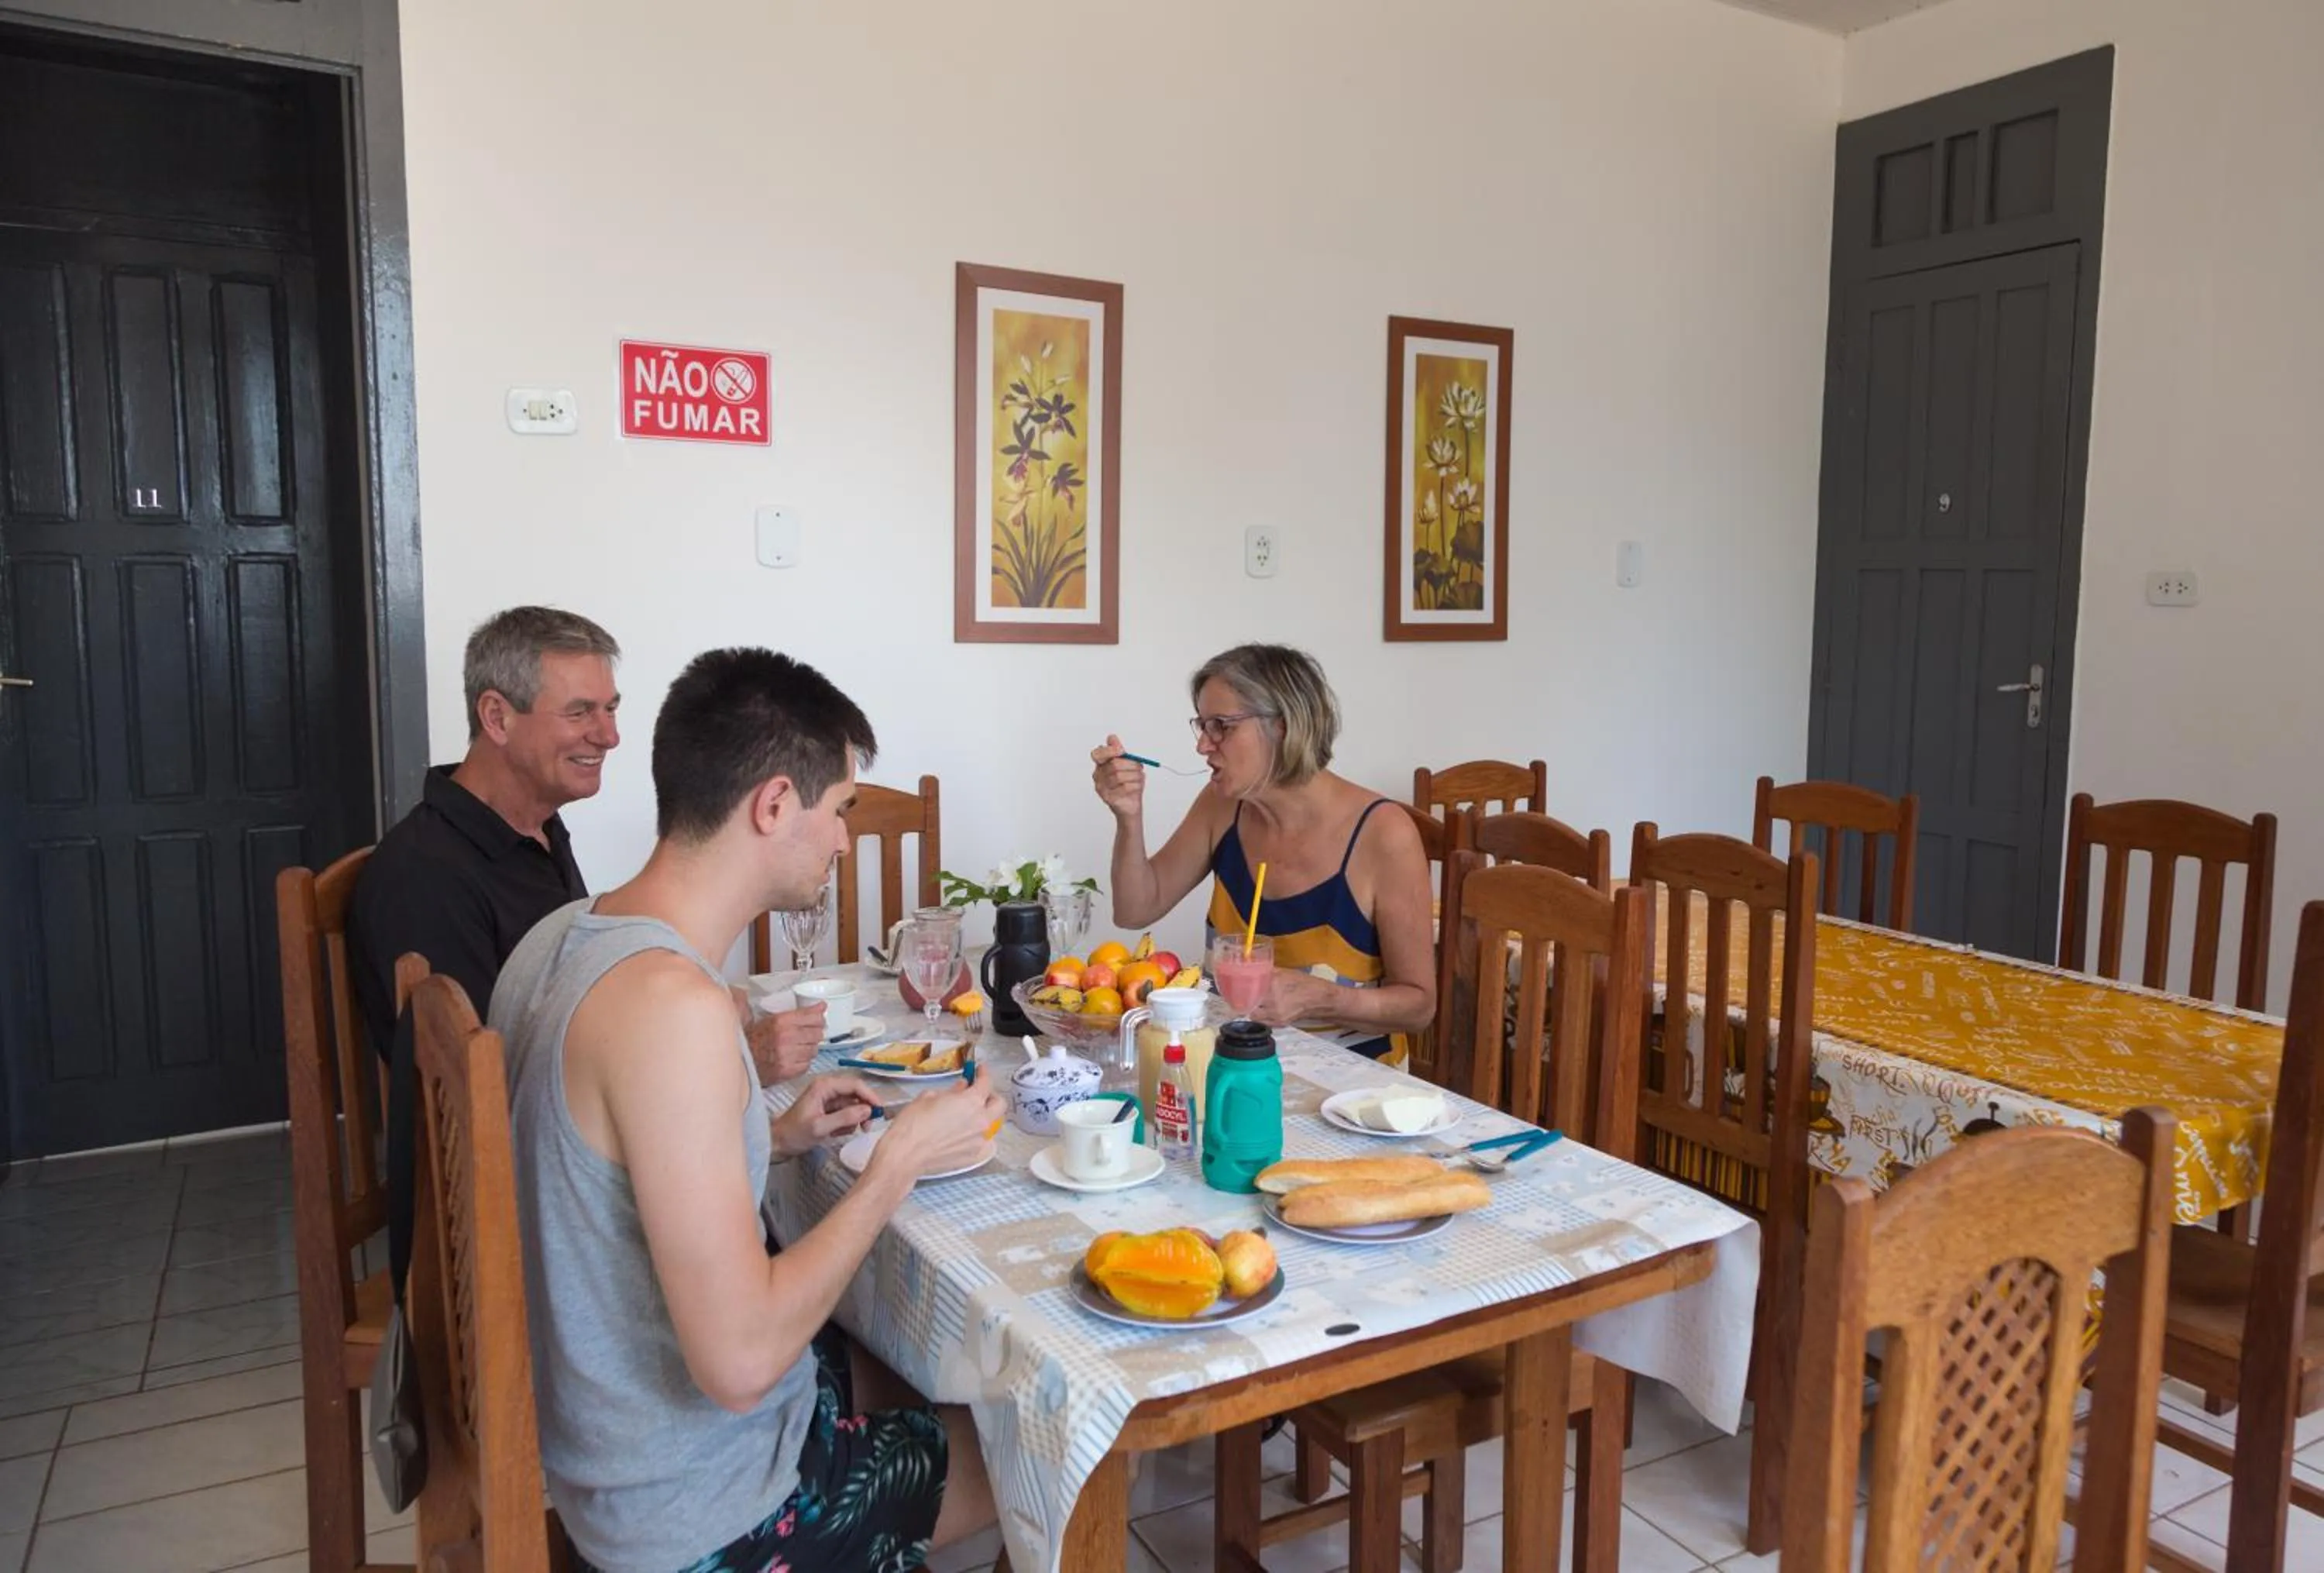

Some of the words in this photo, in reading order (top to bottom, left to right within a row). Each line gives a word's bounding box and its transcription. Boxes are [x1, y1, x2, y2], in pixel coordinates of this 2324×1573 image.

[634, 349, 708, 398] NÃO
[634, 399, 761, 435] FUMAR
[134, 488, 162, 508] 11
[1939, 492, 1951, 512] 9
